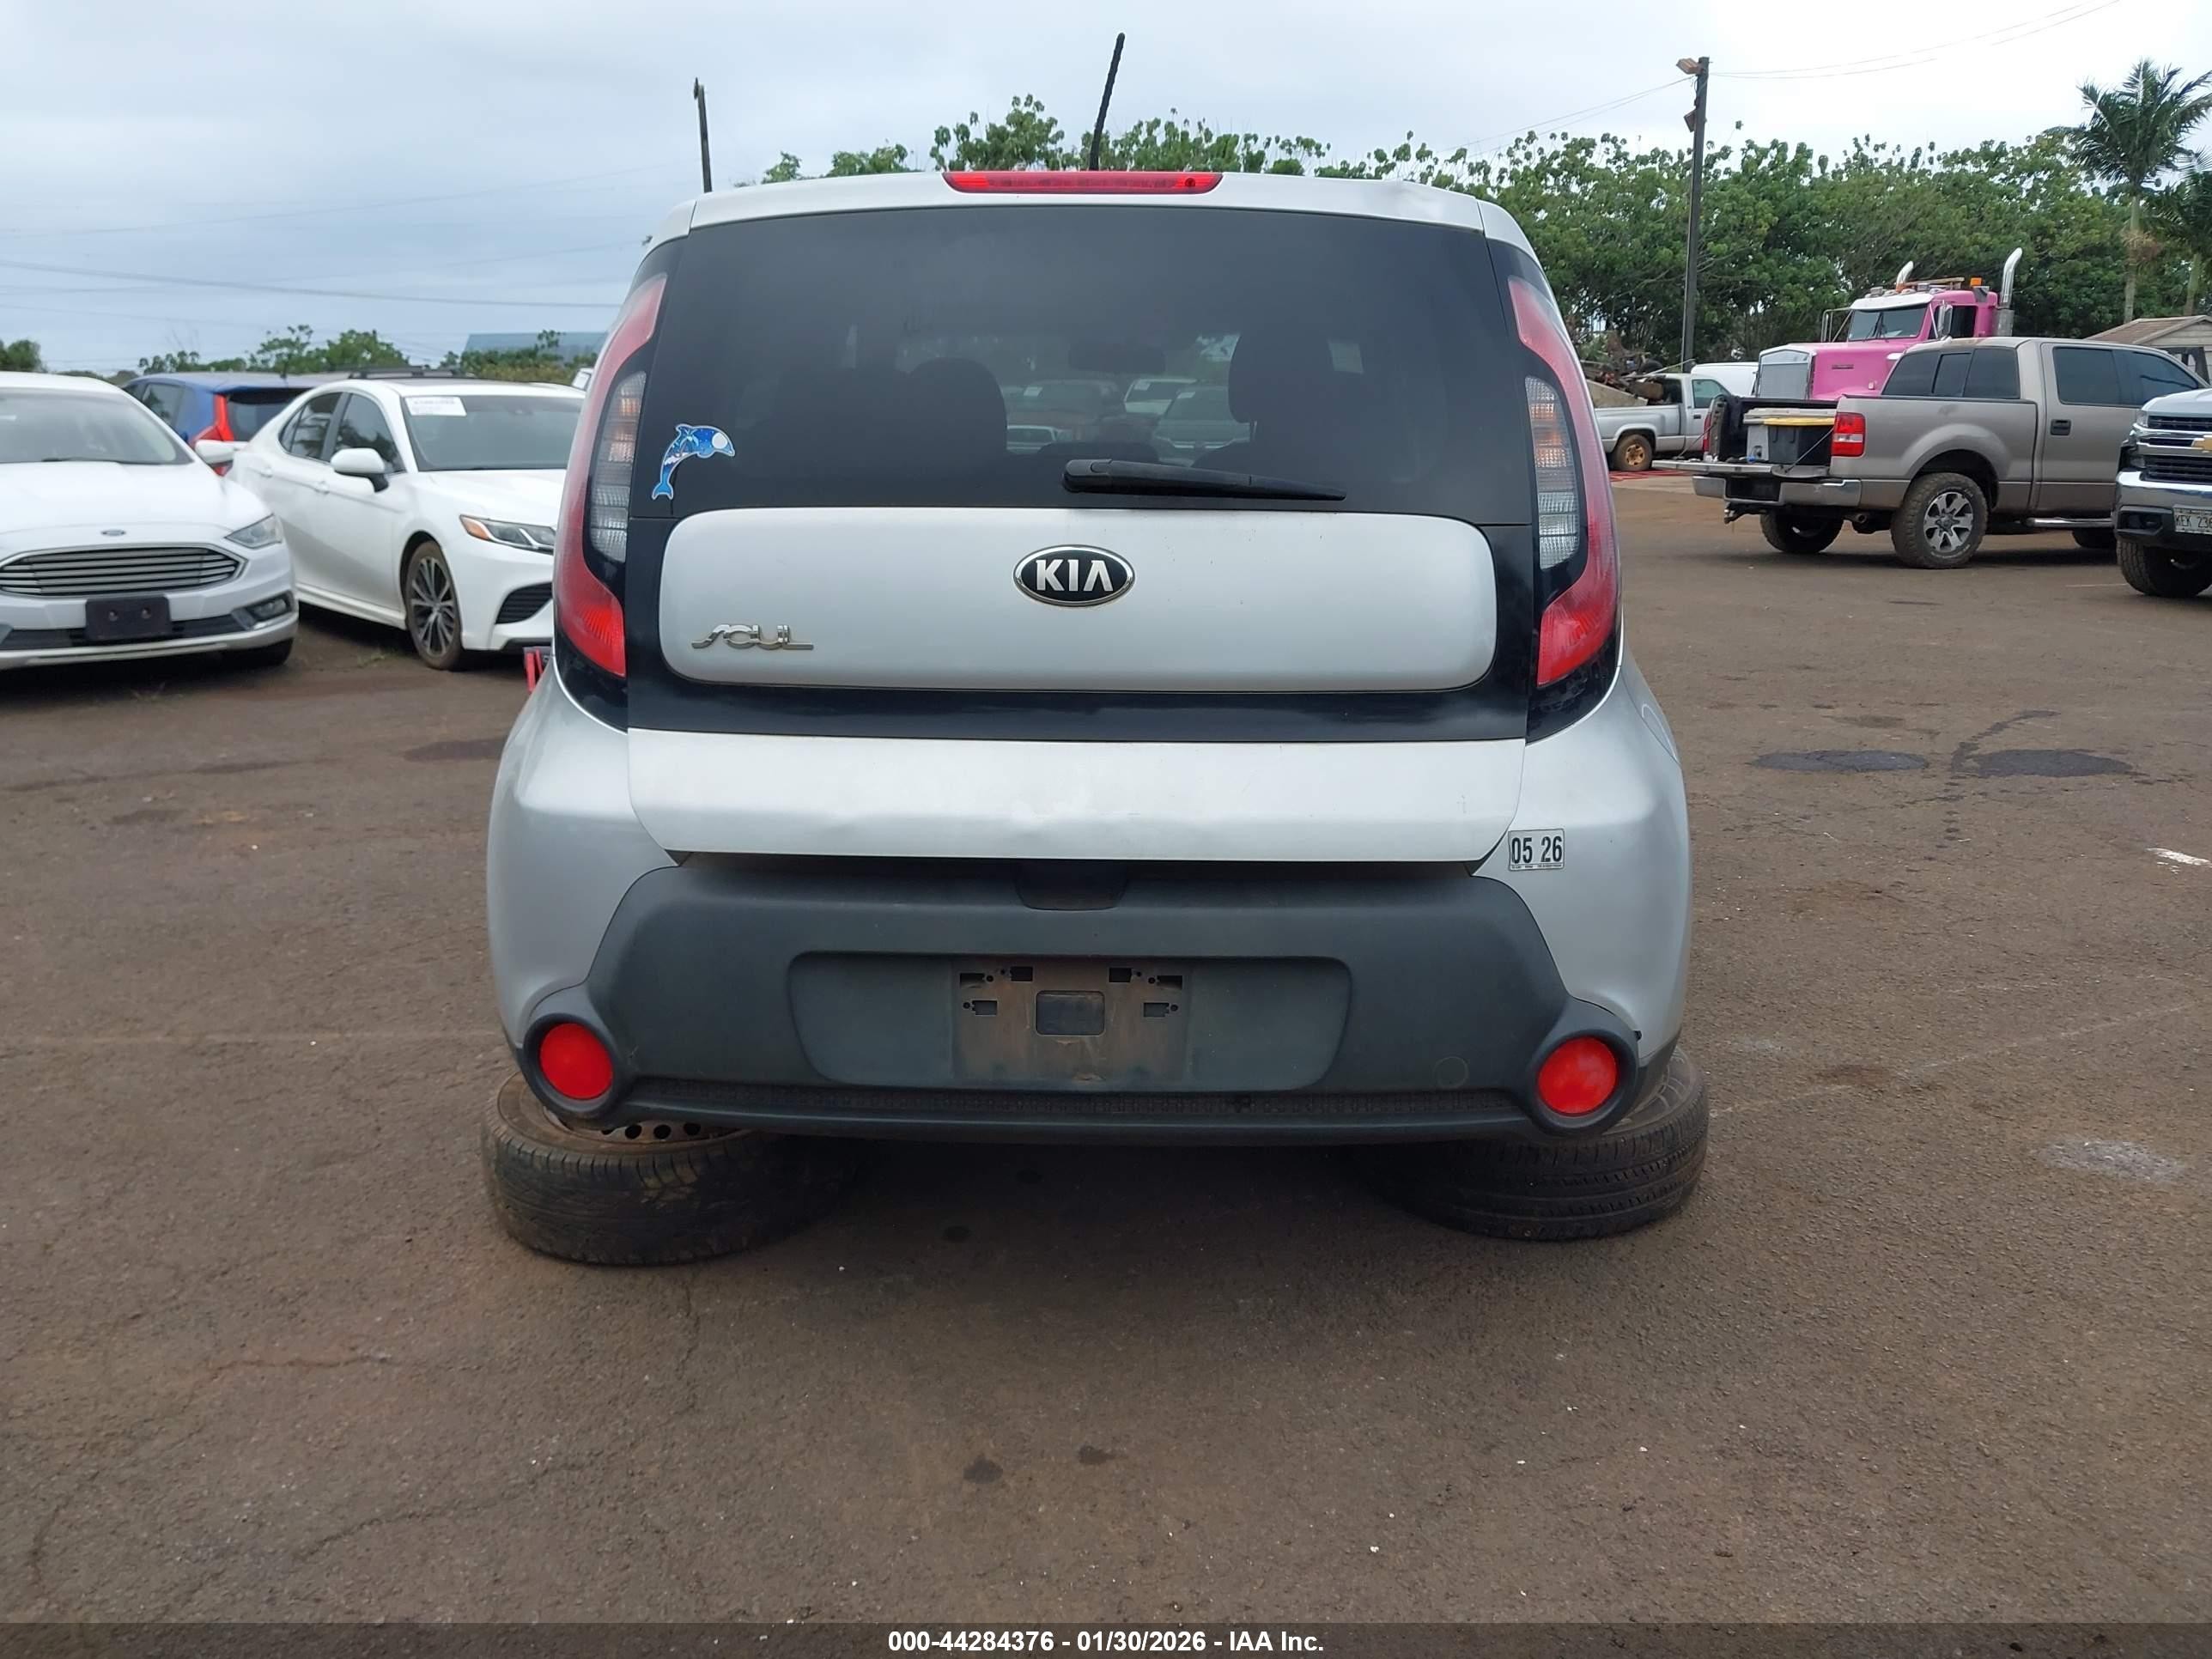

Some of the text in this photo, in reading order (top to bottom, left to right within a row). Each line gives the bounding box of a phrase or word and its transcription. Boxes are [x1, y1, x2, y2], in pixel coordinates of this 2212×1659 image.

[1036, 558, 1114, 592] KIA
[691, 623, 814, 651] SOUL
[1511, 836, 1563, 864] 05 26
